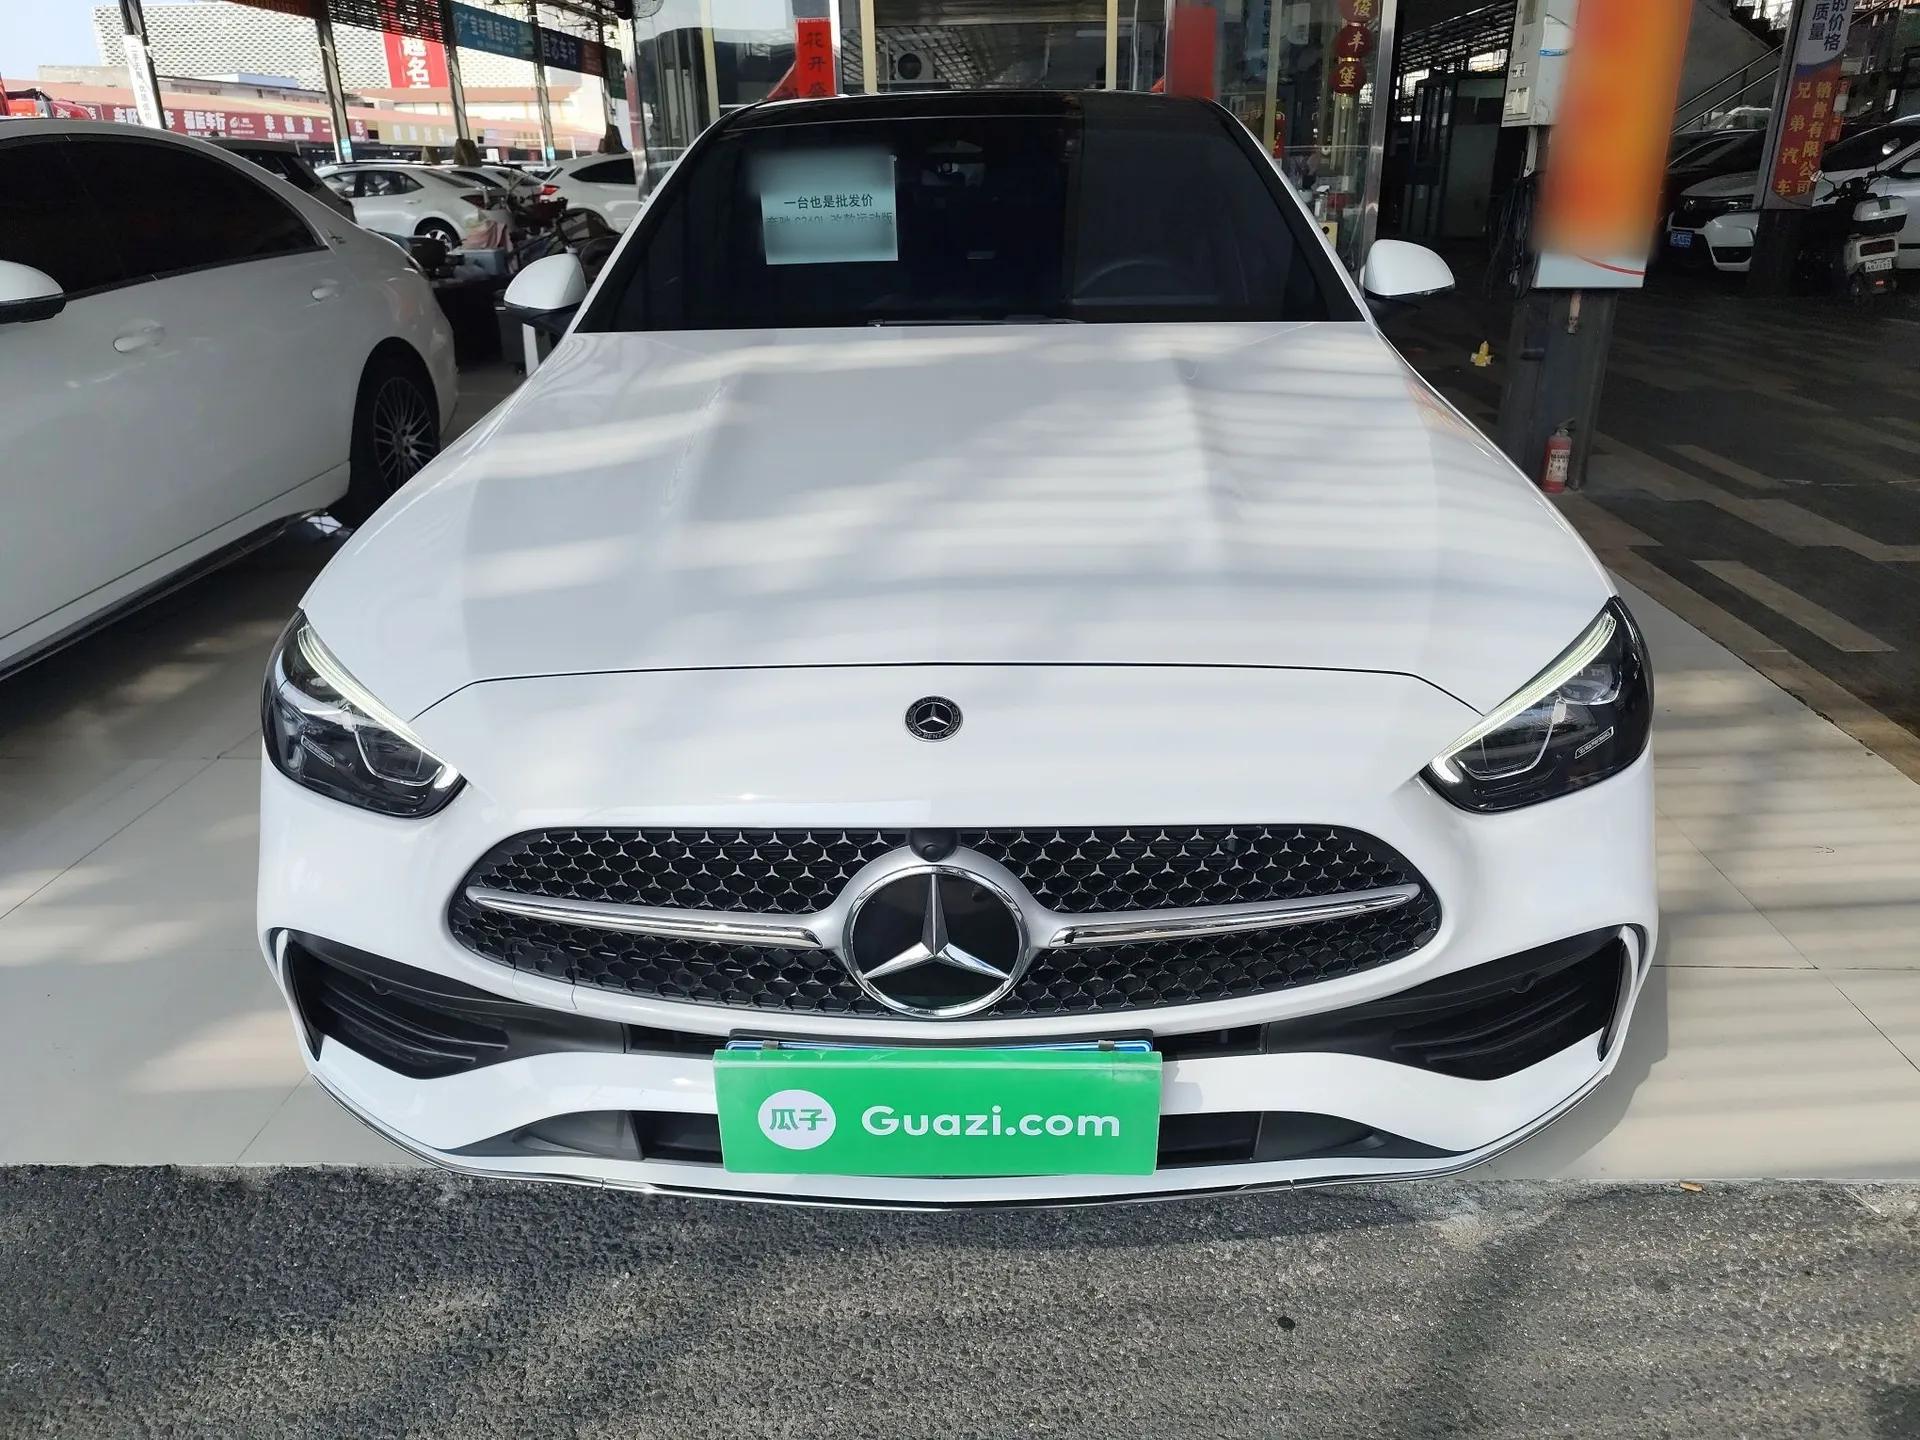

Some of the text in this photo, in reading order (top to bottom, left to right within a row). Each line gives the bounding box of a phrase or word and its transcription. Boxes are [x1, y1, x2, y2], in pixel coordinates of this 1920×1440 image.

[1776, 82, 1811, 196] 兄弟汽车
[784, 193, 873, 209] 一台也是批发价
[769, 1108, 828, 1131] 瓜子
[861, 1105, 1120, 1137] Guazi.com
